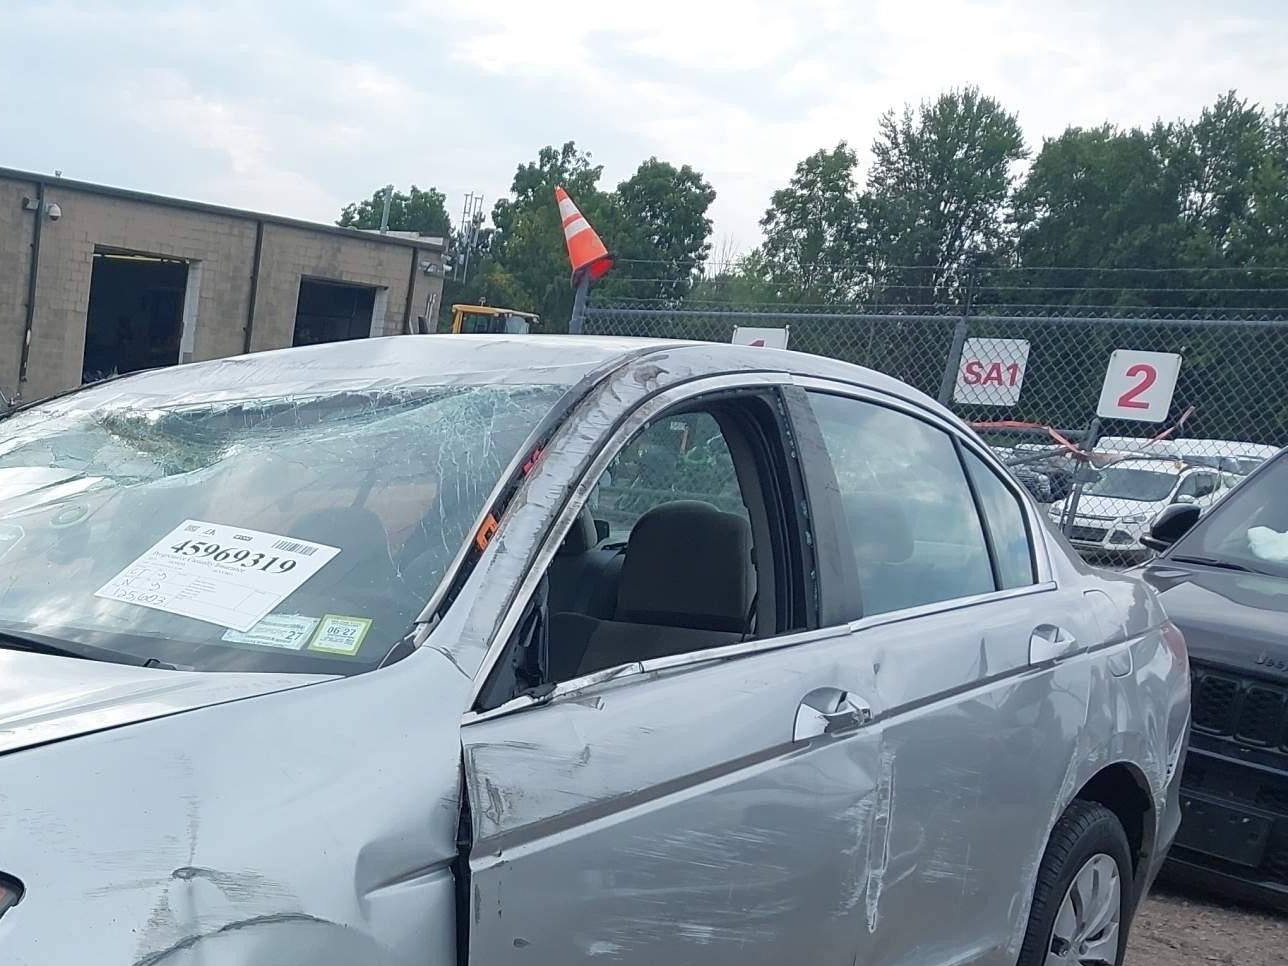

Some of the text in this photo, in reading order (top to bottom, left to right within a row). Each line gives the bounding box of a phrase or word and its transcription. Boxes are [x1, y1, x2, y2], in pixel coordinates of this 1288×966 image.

[964, 361, 1019, 386] SA1
[1117, 364, 1157, 409] 2
[170, 539, 297, 574] 45969319
[284, 630, 304, 641] 27
